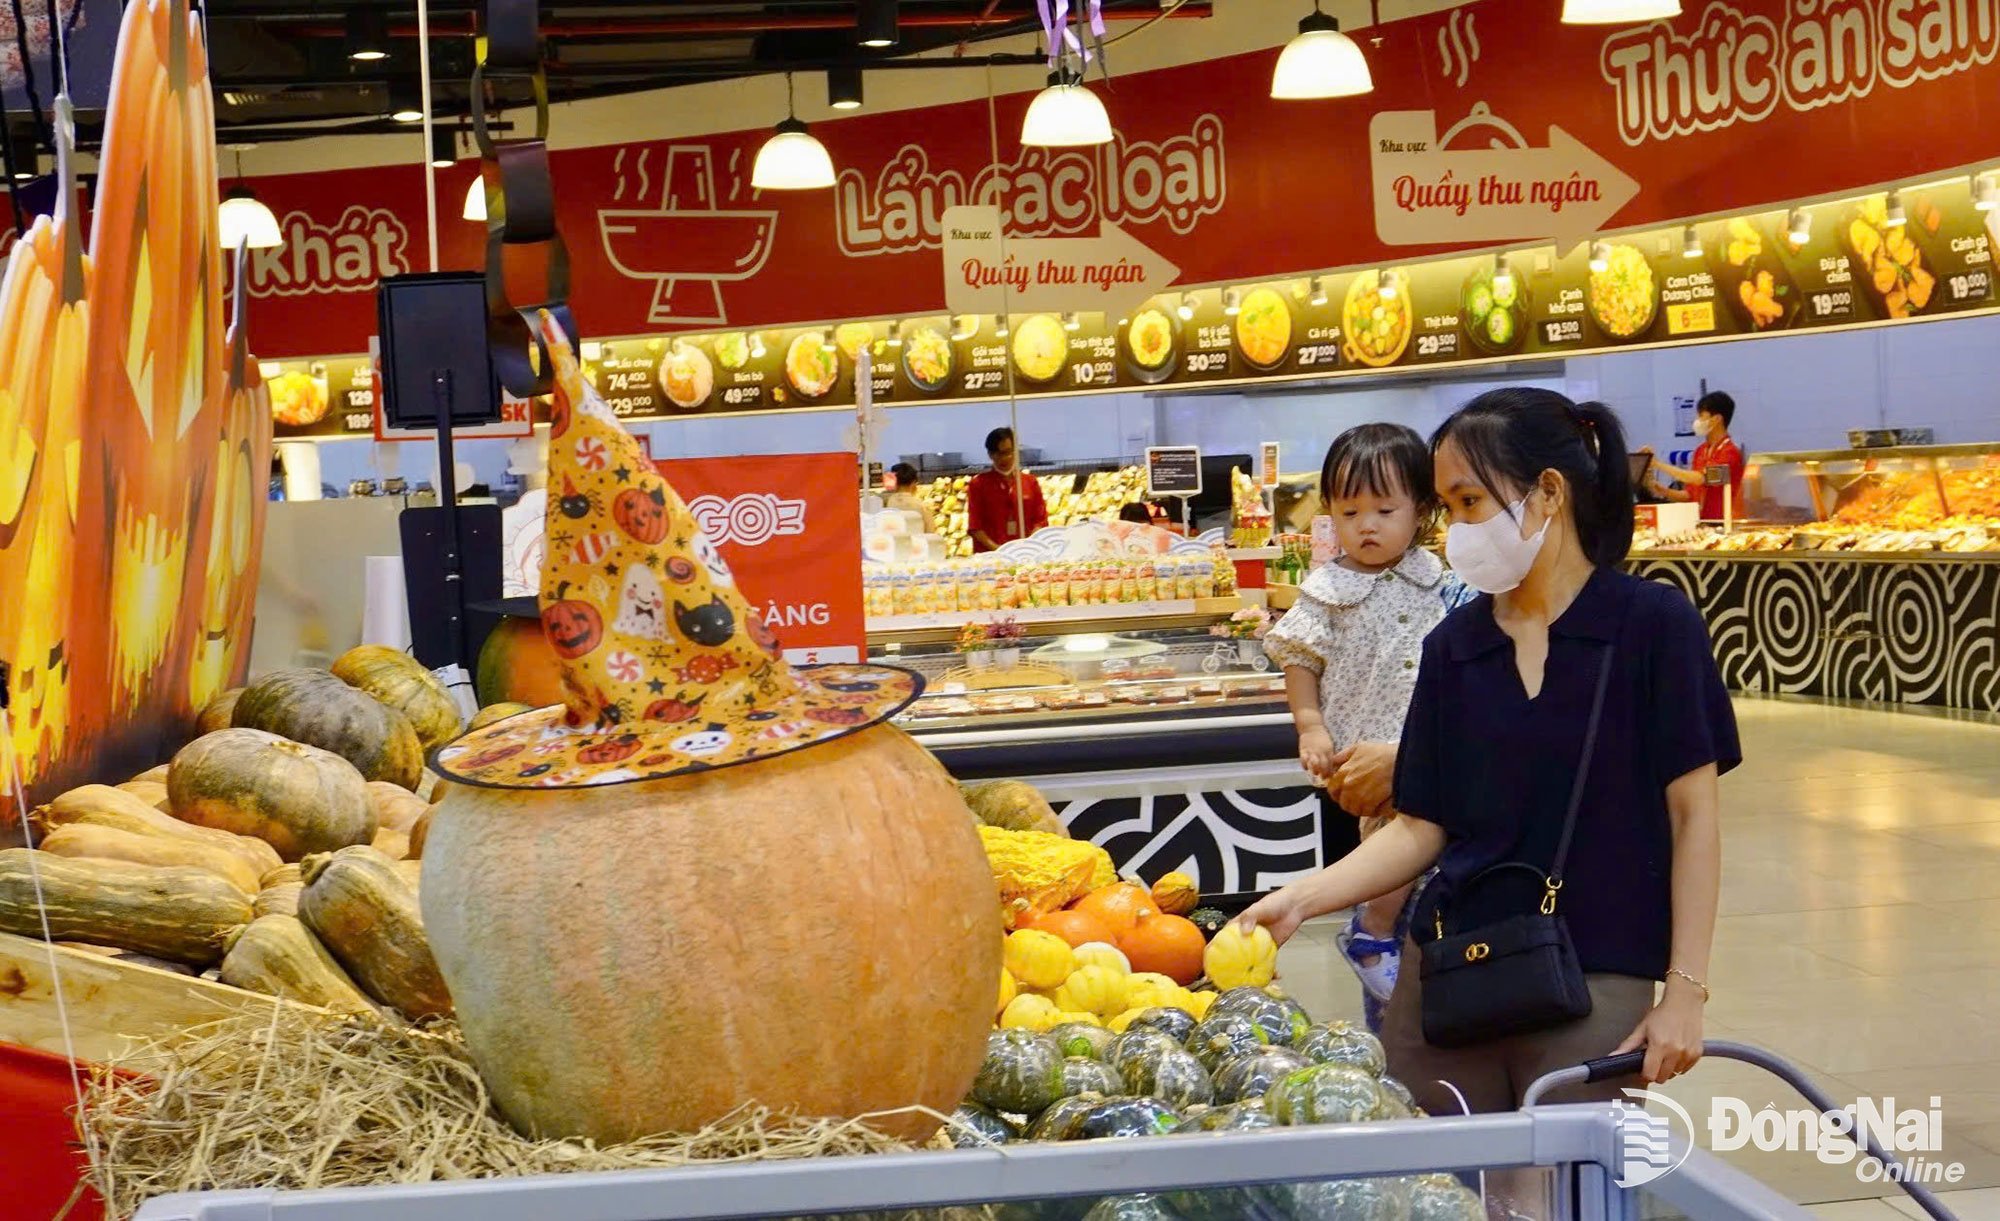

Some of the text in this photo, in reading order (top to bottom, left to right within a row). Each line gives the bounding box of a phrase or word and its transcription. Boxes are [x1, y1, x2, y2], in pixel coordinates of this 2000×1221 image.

[1606, 11, 1774, 136] Thức
[1380, 140, 1426, 154] Khu vực
[841, 121, 1219, 249] Lẩu các loại
[1393, 170, 1601, 216] Quầy thu ngân
[951, 229, 993, 241] Khu vực
[250, 212, 404, 291] khát
[961, 255, 1146, 292] Quầy thu ngân
[1418, 334, 1456, 354] 29.500
[1187, 353, 1227, 372] 30.000
[1299, 345, 1335, 365] 27.000
[964, 371, 1003, 389] 27.000
[1072, 362, 1114, 383] 10.000
[724, 387, 760, 404] 49.000
